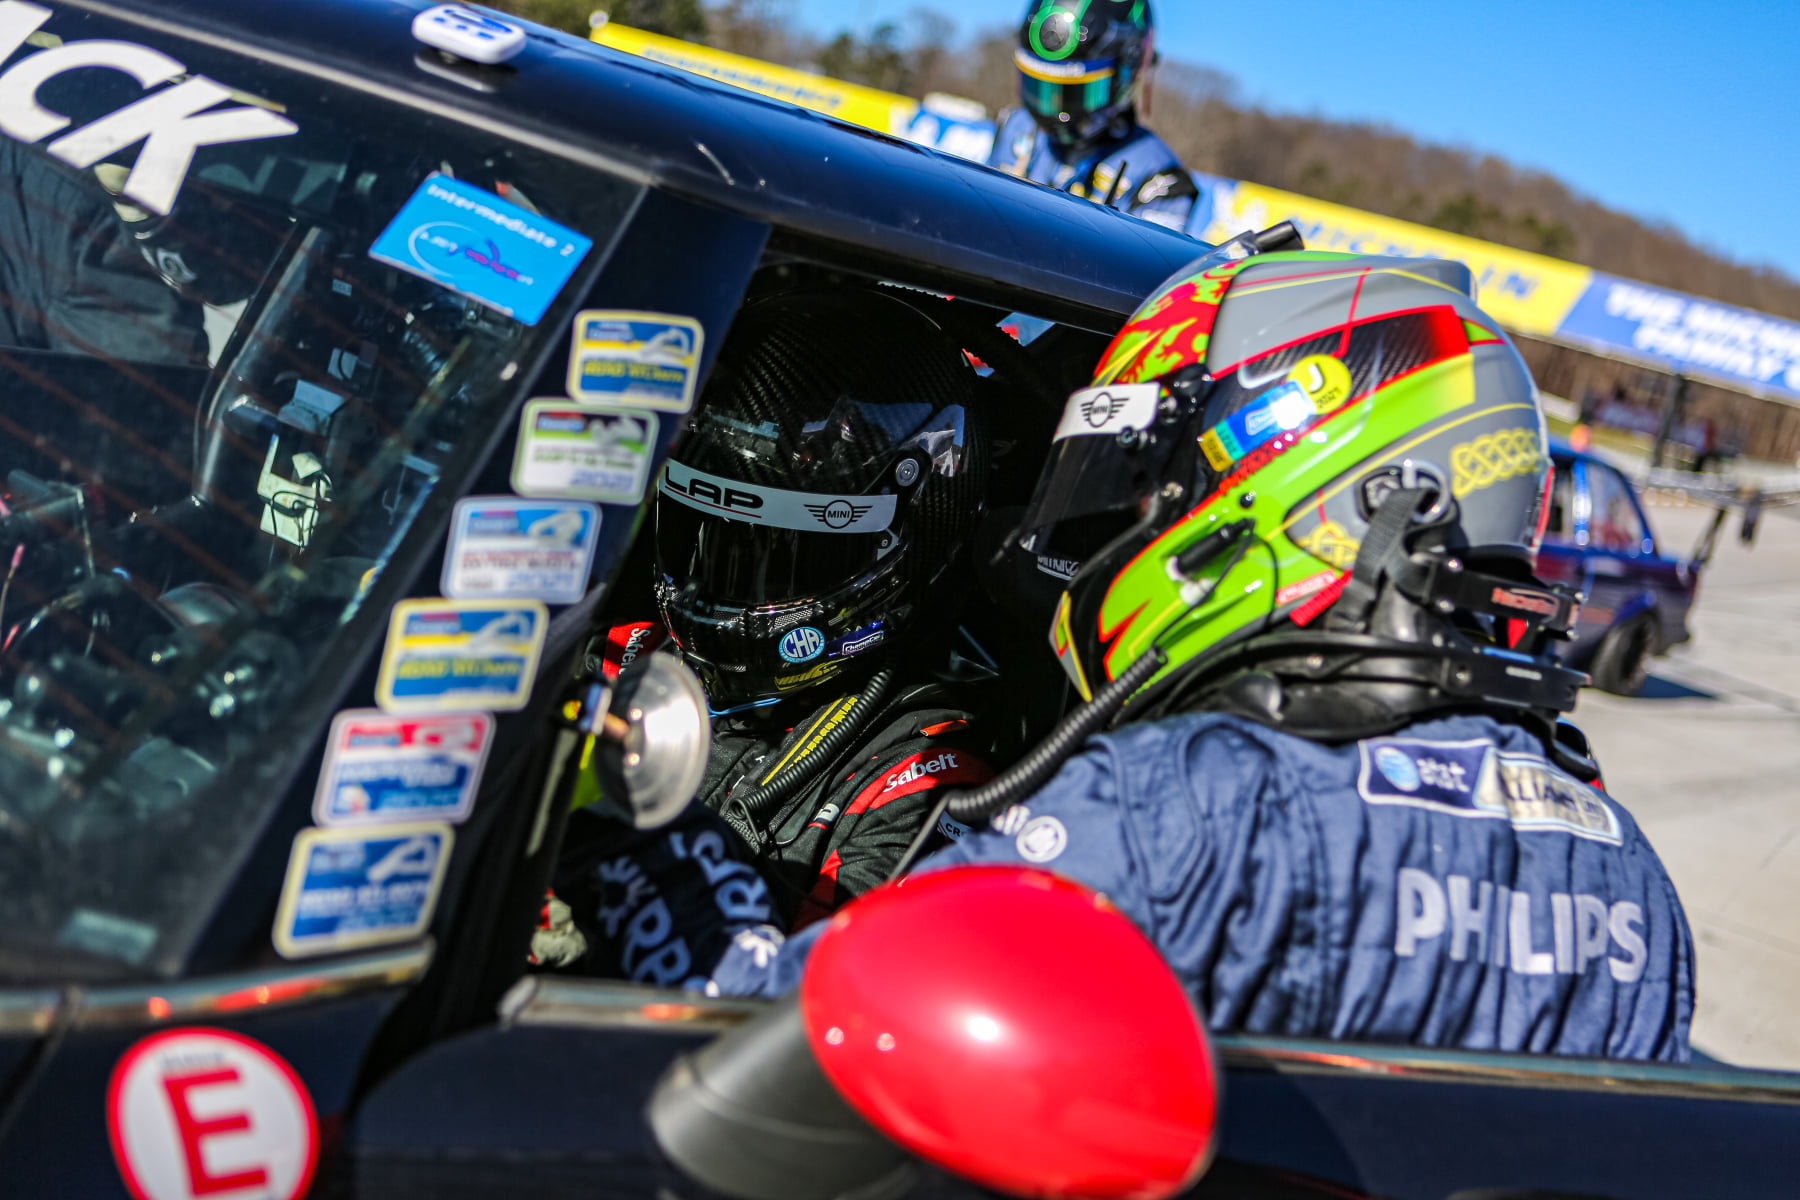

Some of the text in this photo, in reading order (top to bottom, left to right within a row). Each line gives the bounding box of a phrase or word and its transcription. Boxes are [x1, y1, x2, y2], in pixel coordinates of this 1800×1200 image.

[426, 183, 576, 257] Intermediate 2
[1306, 364, 1326, 393] J
[665, 466, 764, 509] LAP
[827, 510, 851, 519] MINI
[619, 627, 651, 676] Sabe
[783, 628, 820, 658] CHA
[883, 753, 958, 793] Sabelt
[1394, 867, 1648, 983] PHILIPS
[163, 1069, 269, 1198] E
